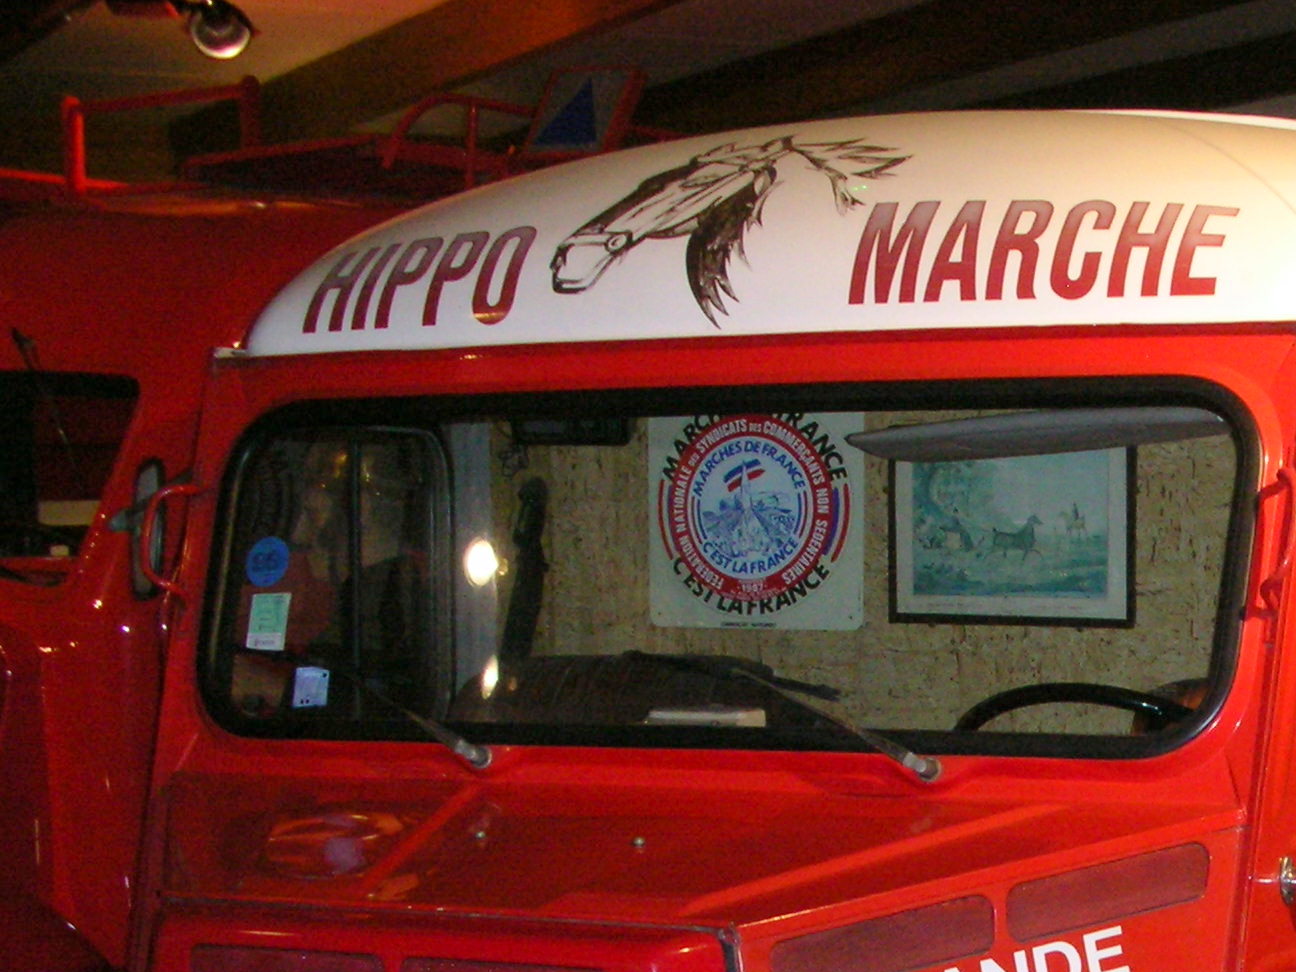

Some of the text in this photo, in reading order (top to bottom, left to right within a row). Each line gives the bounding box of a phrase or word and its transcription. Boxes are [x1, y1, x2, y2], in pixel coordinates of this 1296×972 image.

[302, 199, 1241, 334] HIPPO MARCHE
[699, 419, 748, 454] SYNDICATS
[816, 487, 830, 515] NON
[744, 441, 760, 453] DE
[761, 442, 806, 490] FRANCE
[775, 413, 848, 481] RANCE
[731, 560, 749, 574] LA
[750, 538, 799, 574] FRANCE
[717, 595, 743, 615] LA
[747, 562, 829, 615] FRANCE
